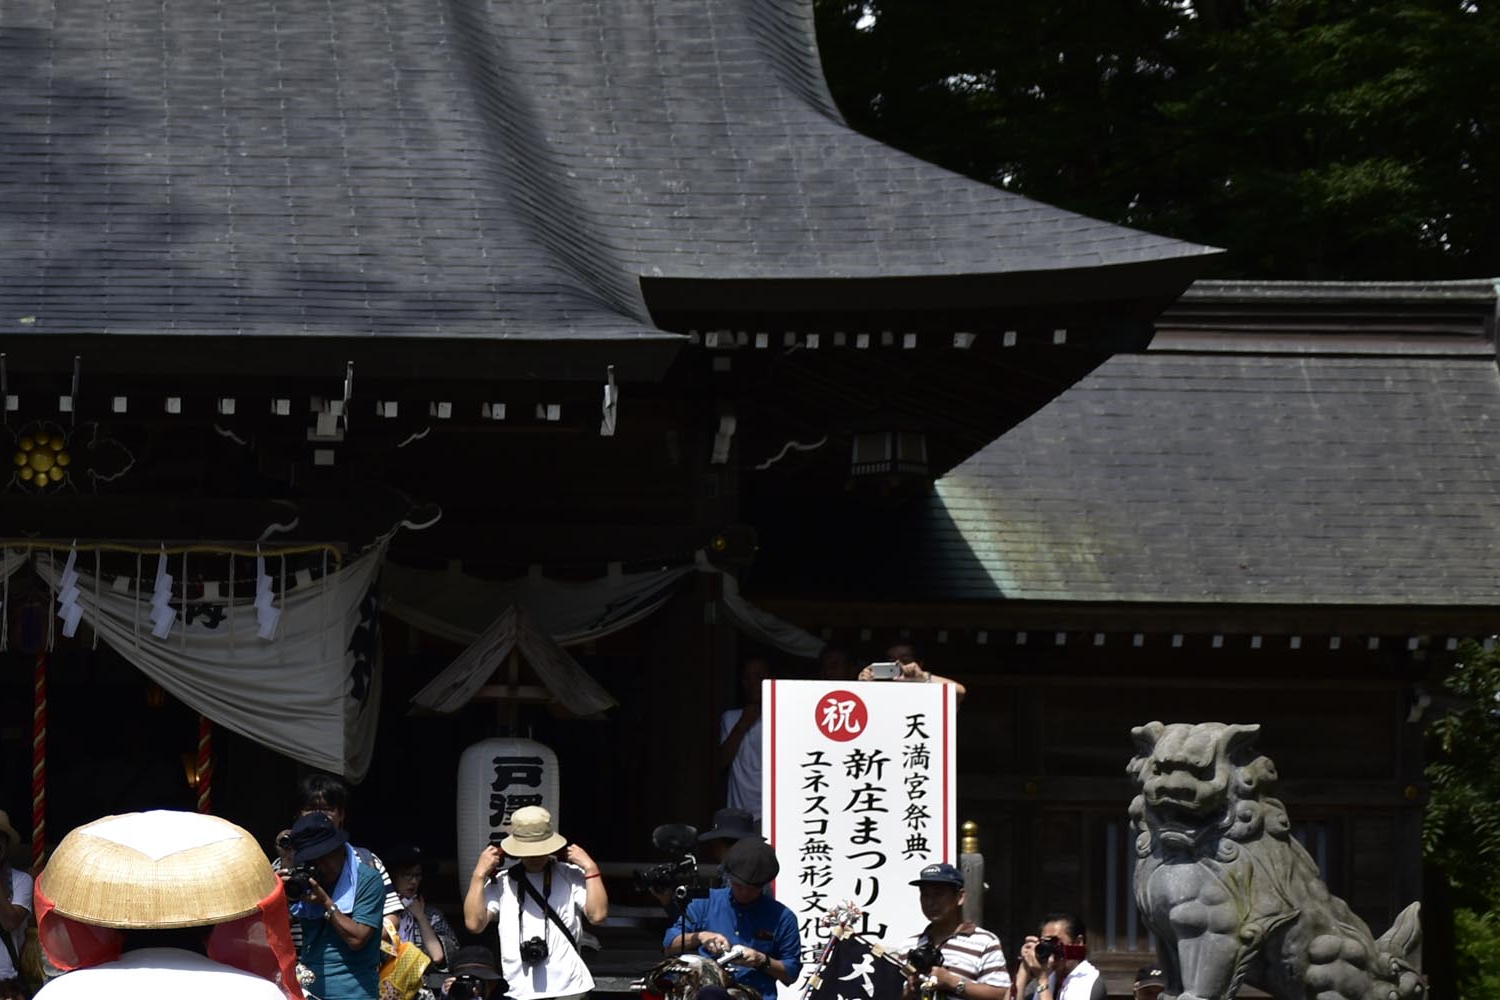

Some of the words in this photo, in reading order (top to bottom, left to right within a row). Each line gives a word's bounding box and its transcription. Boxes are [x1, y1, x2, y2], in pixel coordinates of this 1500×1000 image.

[820, 698, 861, 734] 祝
[900, 713, 932, 861] 天満宮祭典
